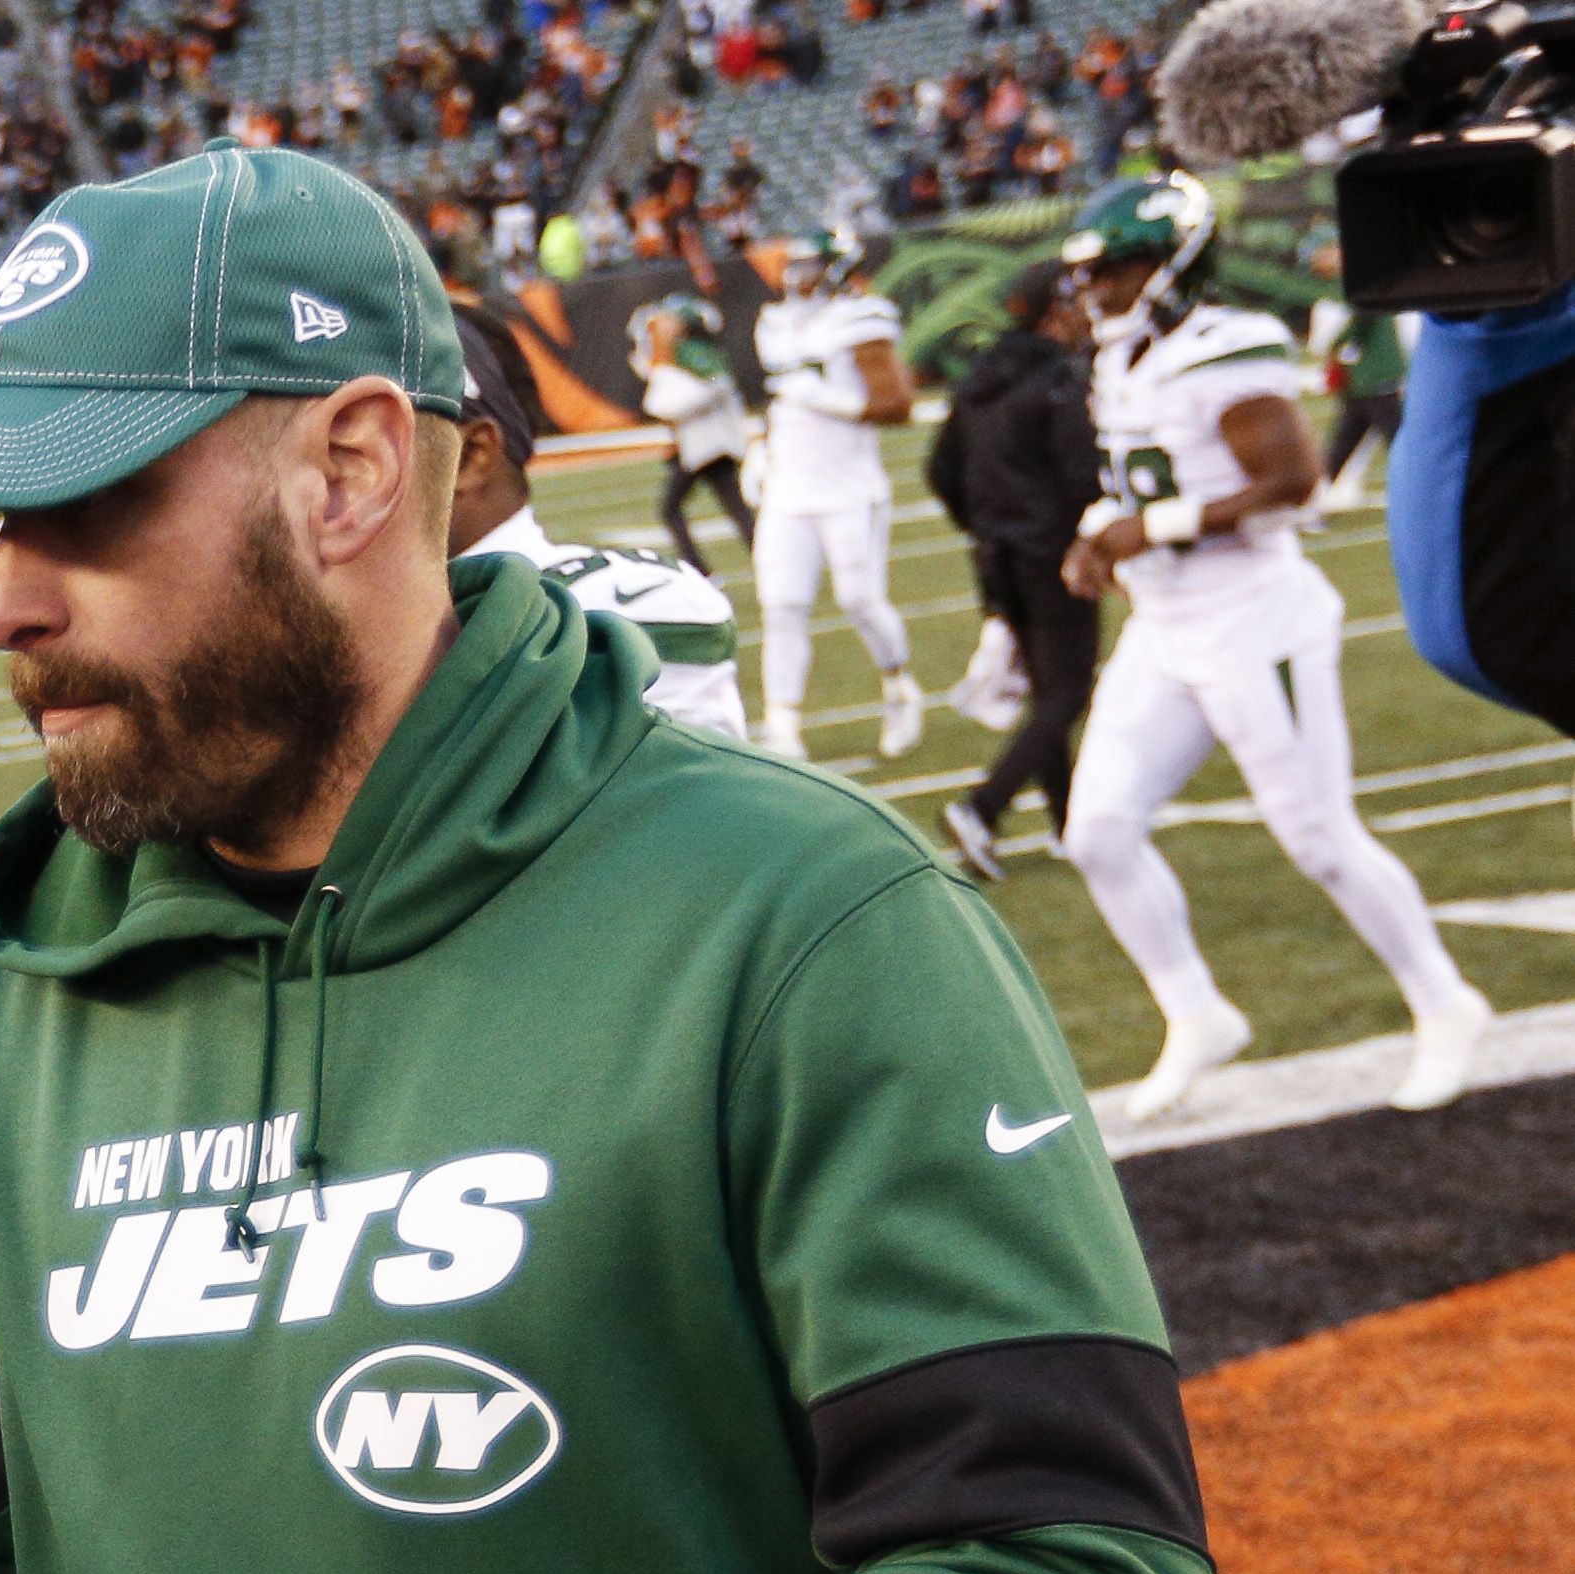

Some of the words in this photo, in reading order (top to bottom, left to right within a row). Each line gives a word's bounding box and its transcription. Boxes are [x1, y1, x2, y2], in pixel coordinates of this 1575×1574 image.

[73, 1134, 173, 1209] NEW
[179, 1111, 300, 1195] YORK
[47, 1150, 551, 1352] JETS
[333, 1390, 533, 1471] NY
